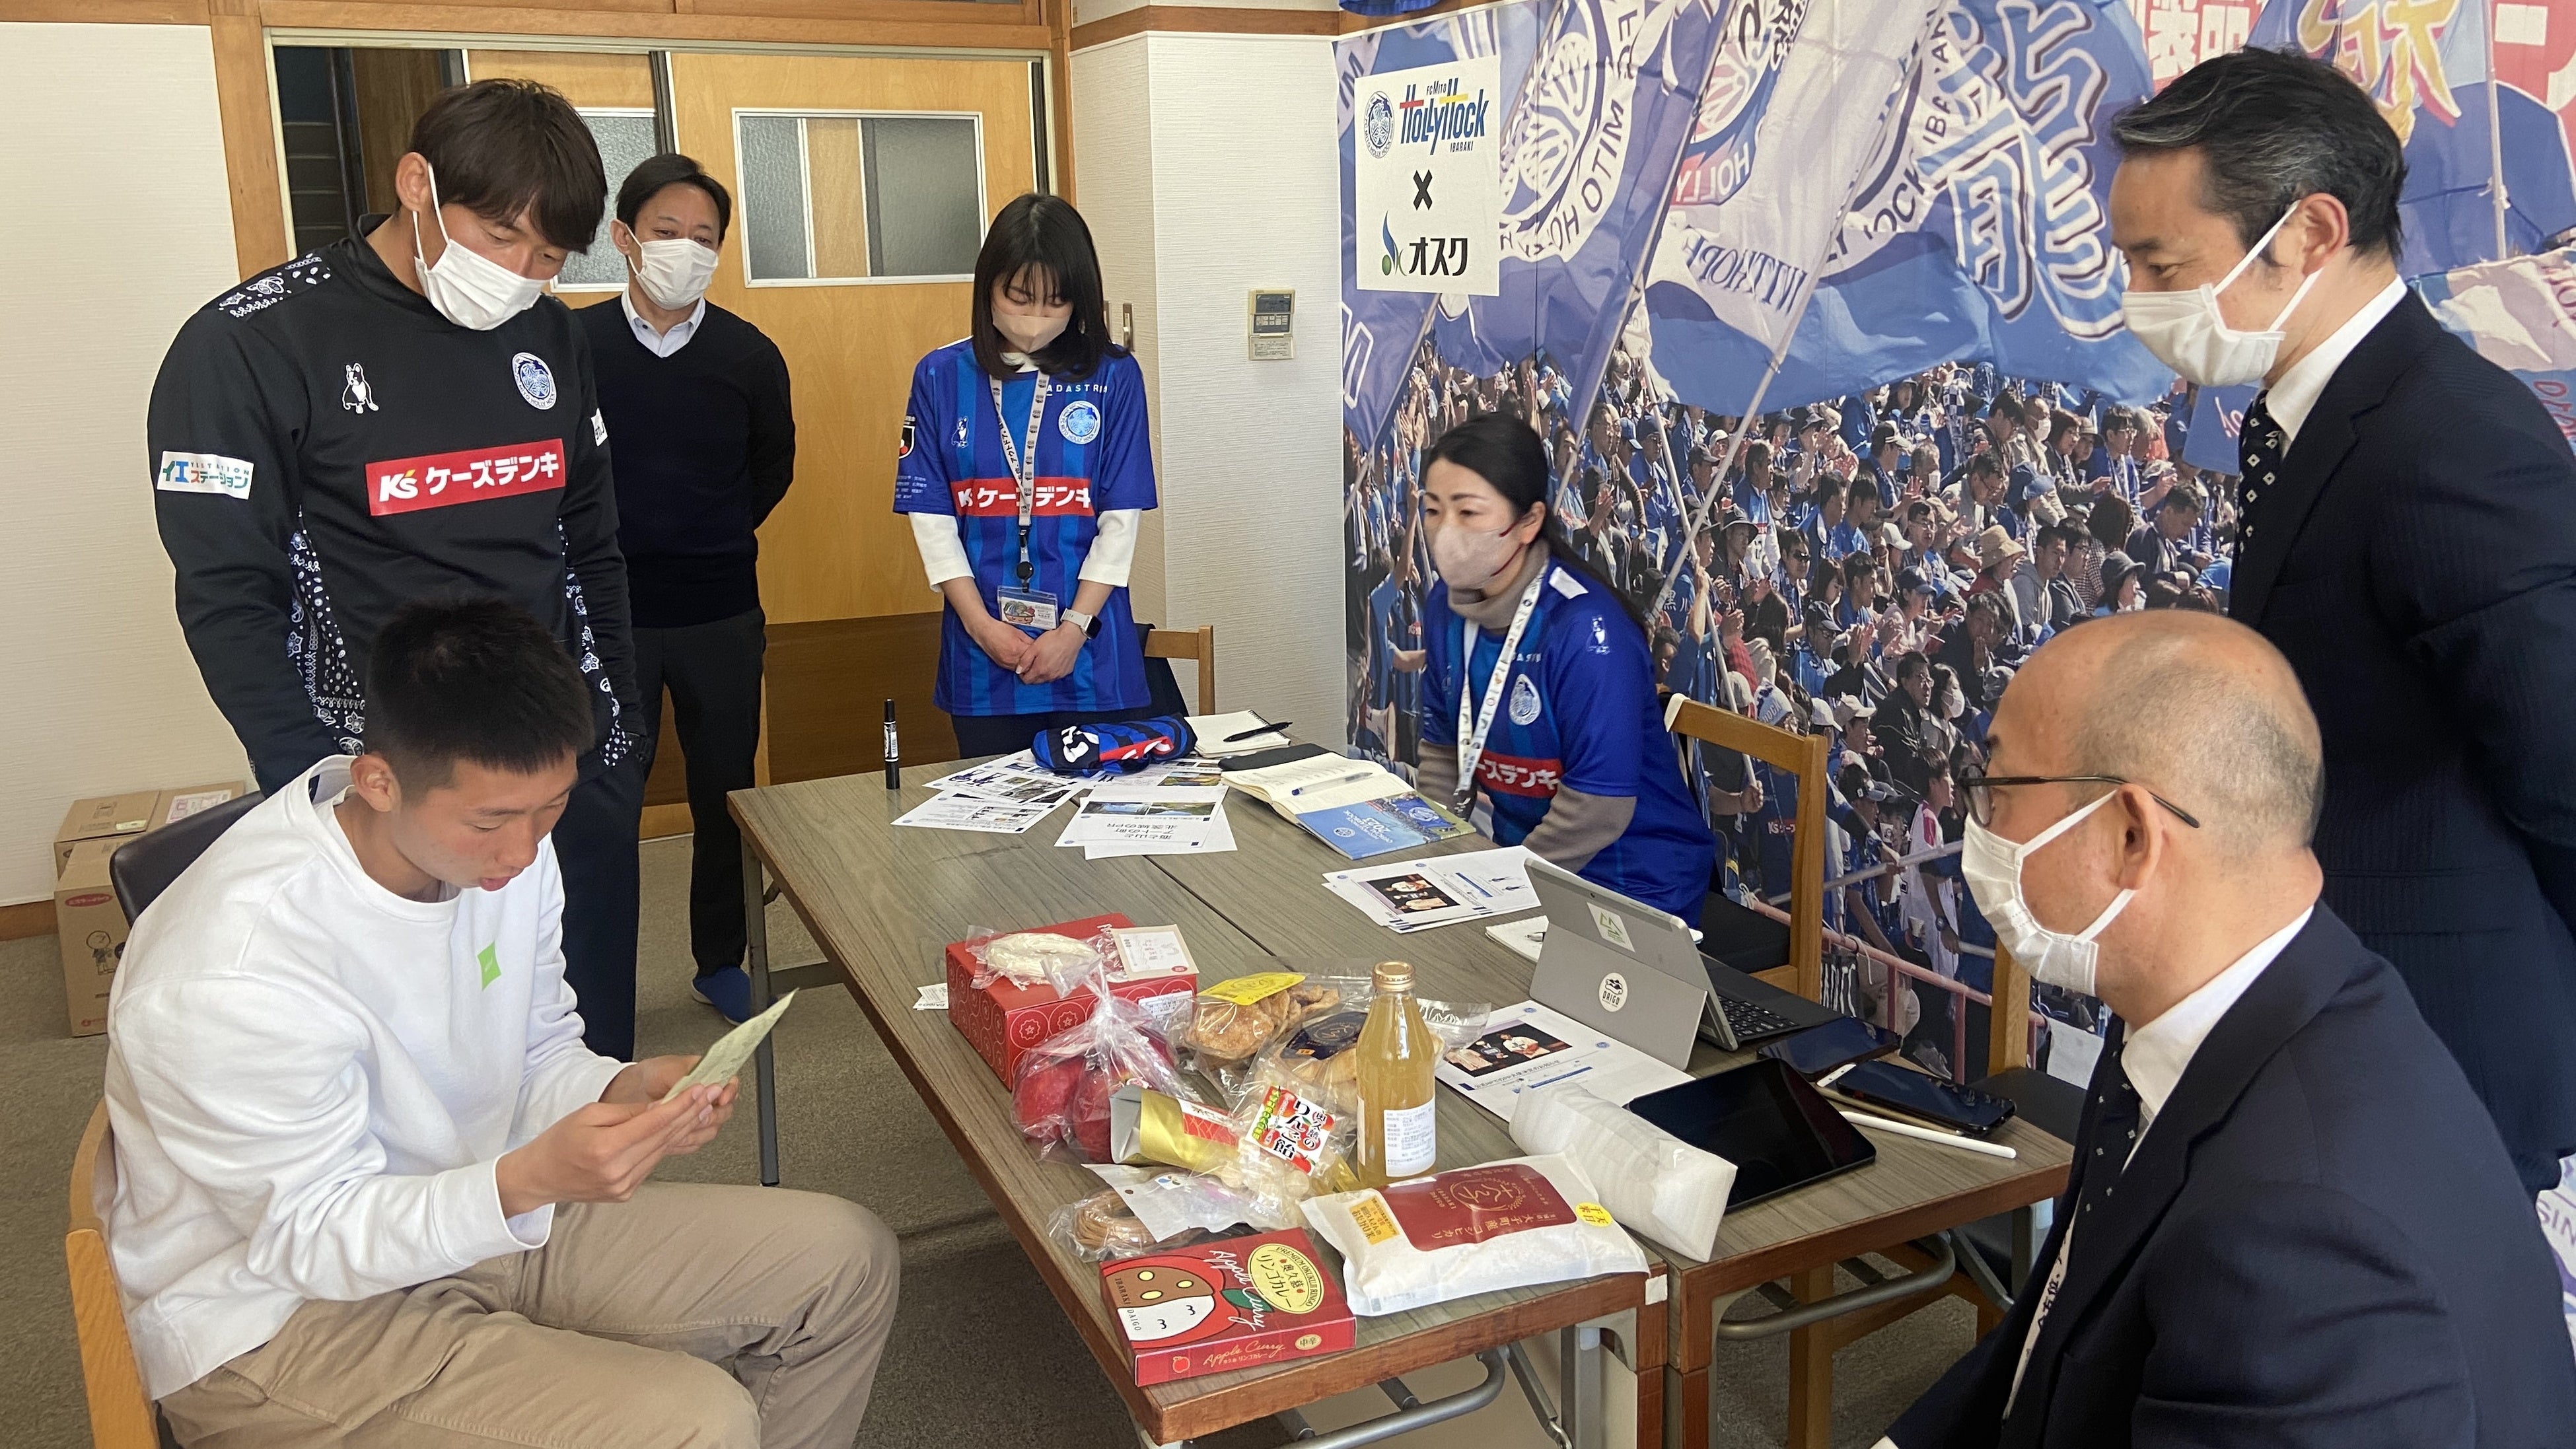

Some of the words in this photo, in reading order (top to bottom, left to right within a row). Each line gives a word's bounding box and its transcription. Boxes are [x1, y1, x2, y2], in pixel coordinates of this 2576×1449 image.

[1450, 140, 1474, 153] IBARAKI
[1409, 236, 1468, 276] オスク
[425, 452, 559, 496] ケーズデンキ
[978, 487, 1091, 509] ケーデンキ
[1273, 1100, 1310, 1159] りんご飴
[1203, 1250, 1252, 1285] Apple
[1276, 1246, 1306, 1266] PREMIUM
[1114, 1277, 1131, 1305] IBARAKI
[1256, 1254, 1292, 1308] リンゴカレー
[1126, 1309, 1142, 1331] DAIGO
[1227, 1286, 1266, 1331] Curry
[1203, 1344, 1242, 1368] Apple
[1244, 1340, 1285, 1359] Curry
[1299, 1337, 1317, 1347] 中辛
